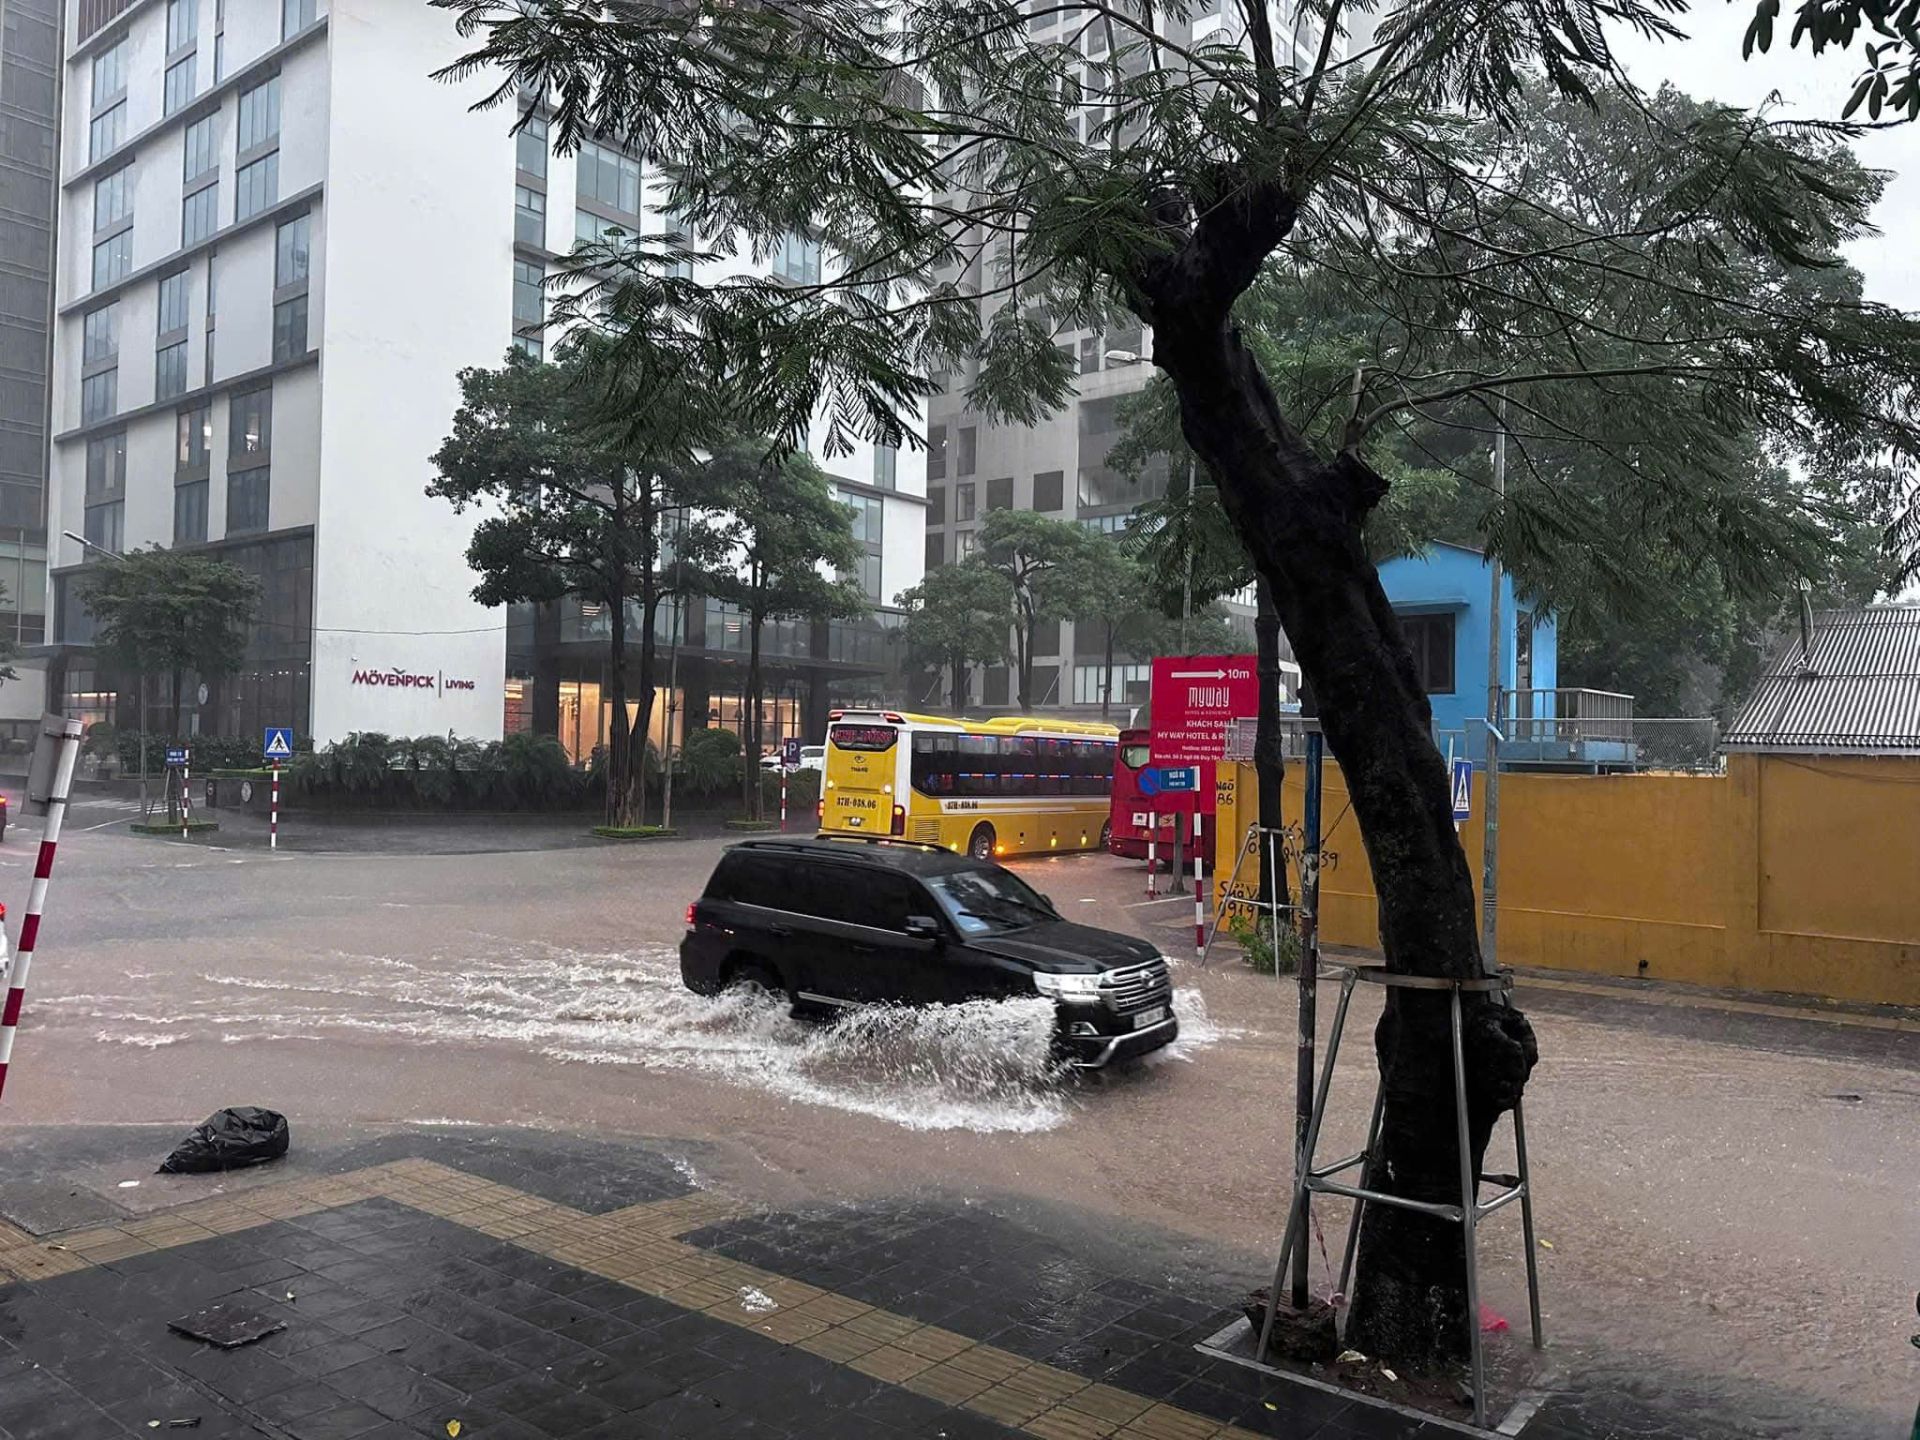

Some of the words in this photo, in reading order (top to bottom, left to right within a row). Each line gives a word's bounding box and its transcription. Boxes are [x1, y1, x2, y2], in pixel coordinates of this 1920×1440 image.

[1227, 669, 1250, 679] 10m
[352, 669, 435, 688] MÖVENPICK
[445, 680, 475, 690] LIVING
[1186, 718, 1213, 728] KHÁCH
[1169, 732, 1185, 740] WAY
[1186, 732, 1210, 740] HOTEL
[1211, 732, 1218, 740] &
[788, 742, 797, 756] P
